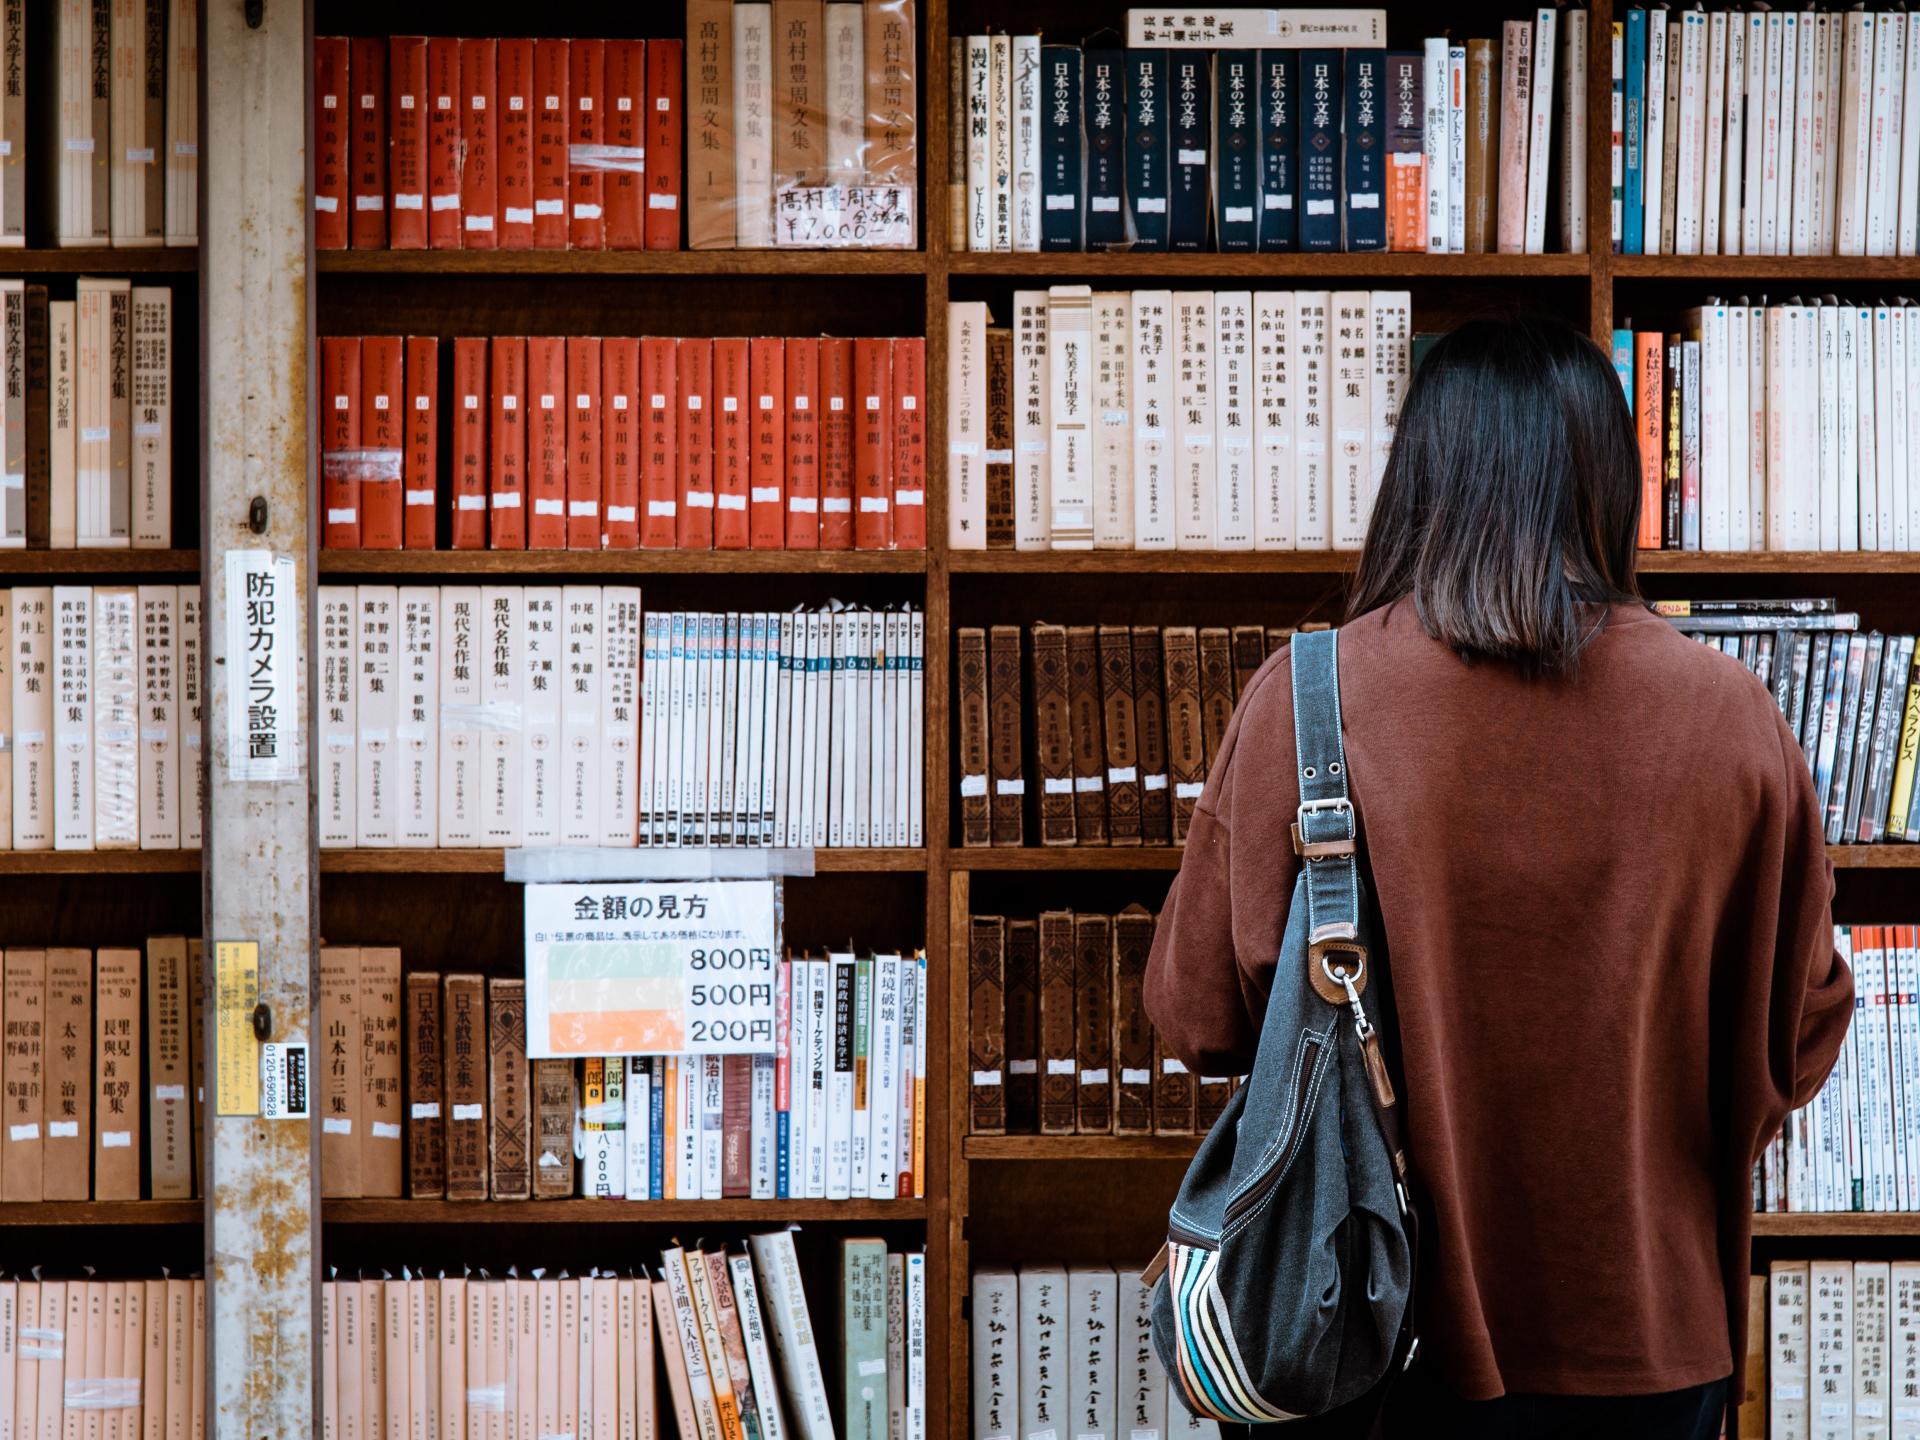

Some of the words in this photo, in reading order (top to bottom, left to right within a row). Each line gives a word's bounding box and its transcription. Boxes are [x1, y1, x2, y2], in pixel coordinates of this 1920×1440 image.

[1656, 33, 1664, 62] ユリイカ
[971, 48, 987, 138] 漫才病棟
[1016, 47, 1039, 111] 天才伝説
[1053, 62, 1070, 126] 日本の文学
[1096, 65, 1111, 129] 日本の文学
[1139, 62, 1155, 126] 日本の文学
[1180, 65, 1196, 129] 日本の文学
[1230, 64, 1246, 128] 日本の文学
[1270, 64, 1286, 127] 日本の文学
[1314, 64, 1329, 129] 日本の文学
[1358, 63, 1374, 127] 日本の文学
[1399, 65, 1414, 128] 日本の文学
[473, 112, 486, 186] 宮本百合子
[974, 187, 985, 239] ビートたけし
[6, 294, 21, 399] 昭和文学全集
[112, 294, 126, 399] 昭和文学全集
[1021, 306, 1032, 356] 遠藤周作
[1139, 306, 1150, 355] 宇野千代
[1235, 306, 1245, 354] 大佛次郎
[1275, 310, 1285, 355] 村山知義
[1341, 309, 1351, 379] 梅崎春生
[1355, 308, 1365, 379] 椎名麟三
[1825, 331, 1833, 359] ユリイカ
[1262, 363, 1272, 407] 三好十郎
[1346, 383, 1360, 397] 集
[144, 408, 158, 423] 集
[1188, 410, 1202, 424] 集
[1268, 413, 1281, 426] 集
[504, 412, 516, 486] 堀辰雄
[579, 412, 591, 485] 山本有三
[616, 412, 627, 486] 石川達三
[761, 412, 773, 482] 舟橋聖一
[867, 413, 880, 487] 野間宏
[20, 602, 32, 673] 永井龍男
[34, 602, 45, 673] 井上靖
[325, 603, 335, 649] 小島信夫
[378, 602, 389, 674] 宇野浩二
[583, 603, 594, 673] 尾崎一雄
[26, 678, 41, 693] 集
[159, 655, 171, 702] 中野好夫
[246, 572, 278, 759] 防犯カメラ設置
[325, 656, 335, 702] 吉行淳之介
[370, 678, 384, 692] 集
[533, 676, 547, 690] 集
[575, 678, 589, 693] 集
[783, 658, 790, 668] 5
[793, 660, 804, 669] 10
[835, 661, 843, 669] 3
[848, 659, 856, 669] 6
[861, 661, 868, 669] 4
[888, 659, 895, 668] 9
[911, 660, 922, 669] 12
[68, 706, 83, 722] 集
[152, 706, 167, 722] 集
[330, 707, 344, 722] 集
[615, 707, 628, 721] 集
[574, 894, 708, 920] 金額の見方
[690, 948, 771, 971] 800円
[26, 997, 38, 1006] 64
[71, 996, 83, 1006] 88
[119, 990, 131, 999] 50
[382, 994, 393, 1003] 91
[691, 984, 771, 1007] 500円
[881, 962, 896, 1021] 環境破壊
[903, 968, 914, 1045] スポーツ科学概論
[691, 1019, 772, 1043] 200円
[837, 968, 848, 1068] 国際政治経済を学ぶ
[18, 1022, 30, 1098] 尾崎一雄
[330, 1021, 346, 1113] 山本有三集
[387, 1016, 398, 1093] 神西清
[265, 1045, 276, 1117] 0120-690828
[109, 1098, 124, 1114] 集
[672, 1259, 701, 1365] どうせ曲った人生さ
[690, 1257, 716, 1333] ファザー・グース
[1792, 1275, 1802, 1341] 横光利一
[1783, 1350, 1797, 1364] 集
[1824, 1379, 1838, 1394] 集
[1864, 1380, 1878, 1395] 集
